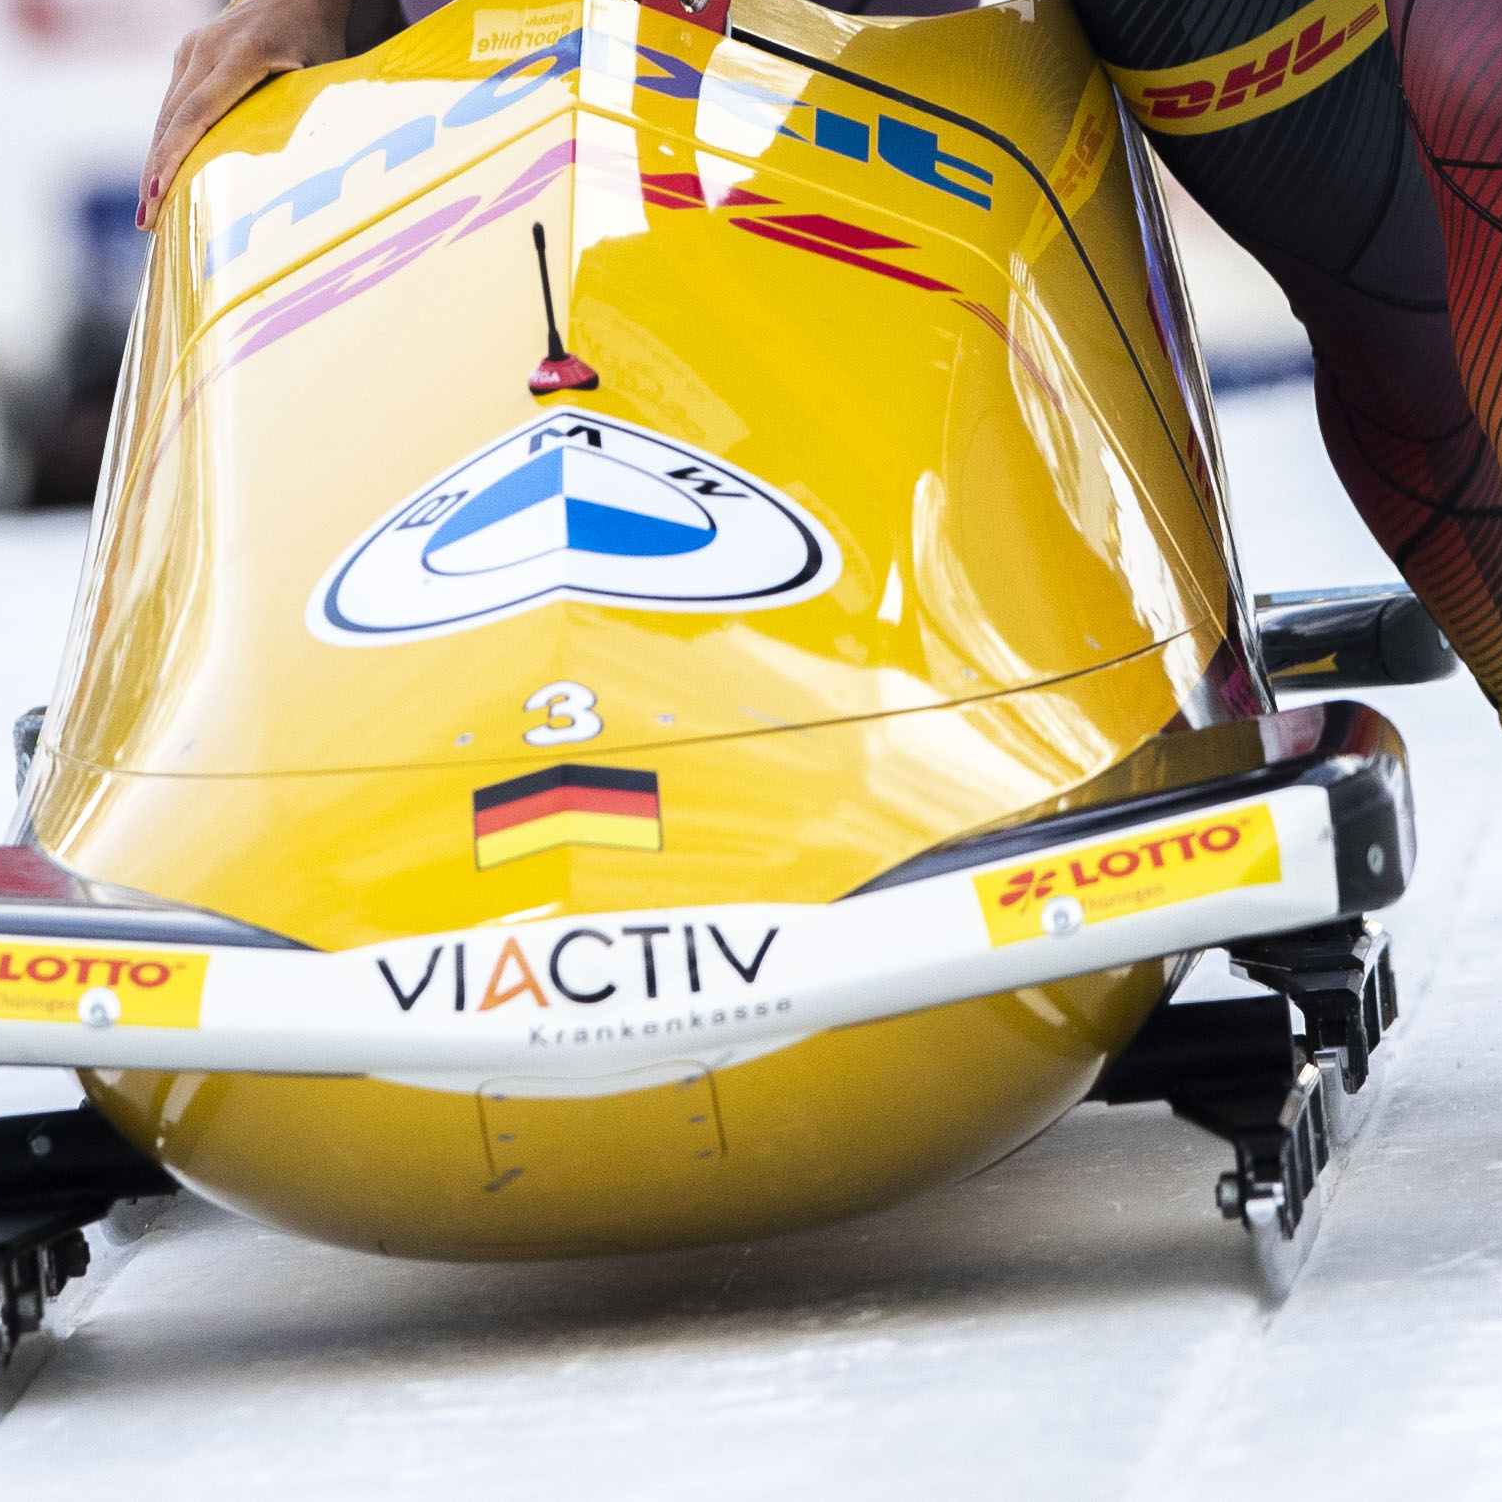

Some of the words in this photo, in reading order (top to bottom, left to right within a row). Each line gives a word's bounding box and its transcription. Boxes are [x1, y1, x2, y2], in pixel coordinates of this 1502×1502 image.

[1143, 16, 1347, 120] DHL
[396, 425, 752, 532] BMW
[521, 680, 605, 747] 3
[1069, 824, 1241, 888] LOTTO
[375, 923, 781, 1013] VIACTIV
[528, 997, 795, 1049] Krankenkasse
